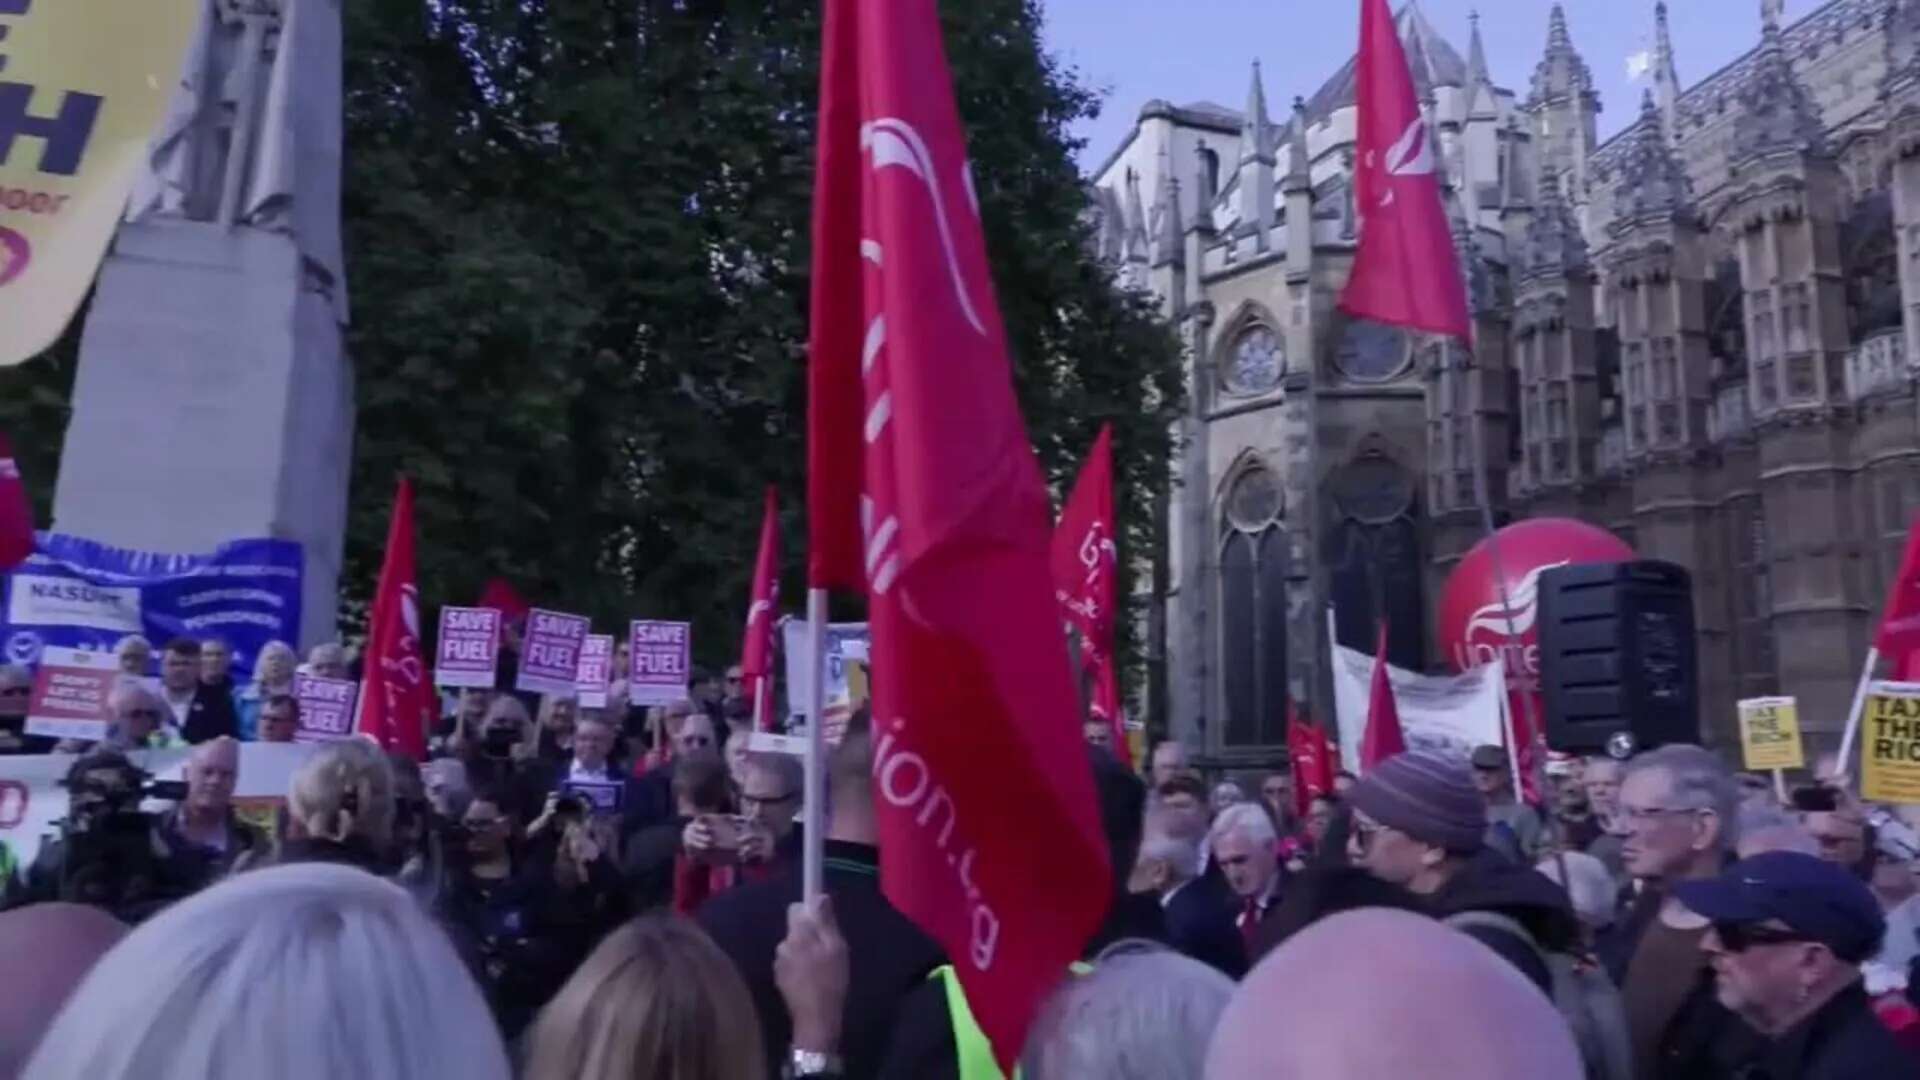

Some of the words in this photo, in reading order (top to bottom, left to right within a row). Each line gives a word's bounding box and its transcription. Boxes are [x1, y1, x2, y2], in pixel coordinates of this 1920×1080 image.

[0, 187, 70, 214] oor
[447, 611, 493, 630] SAVE
[536, 614, 584, 638] SAVE
[637, 625, 684, 643] SAVE
[444, 639, 490, 660] FUEL
[528, 642, 574, 669] FUEL
[636, 652, 684, 674] FUEL
[300, 680, 349, 702] SAVE
[299, 708, 345, 733] FUEL
